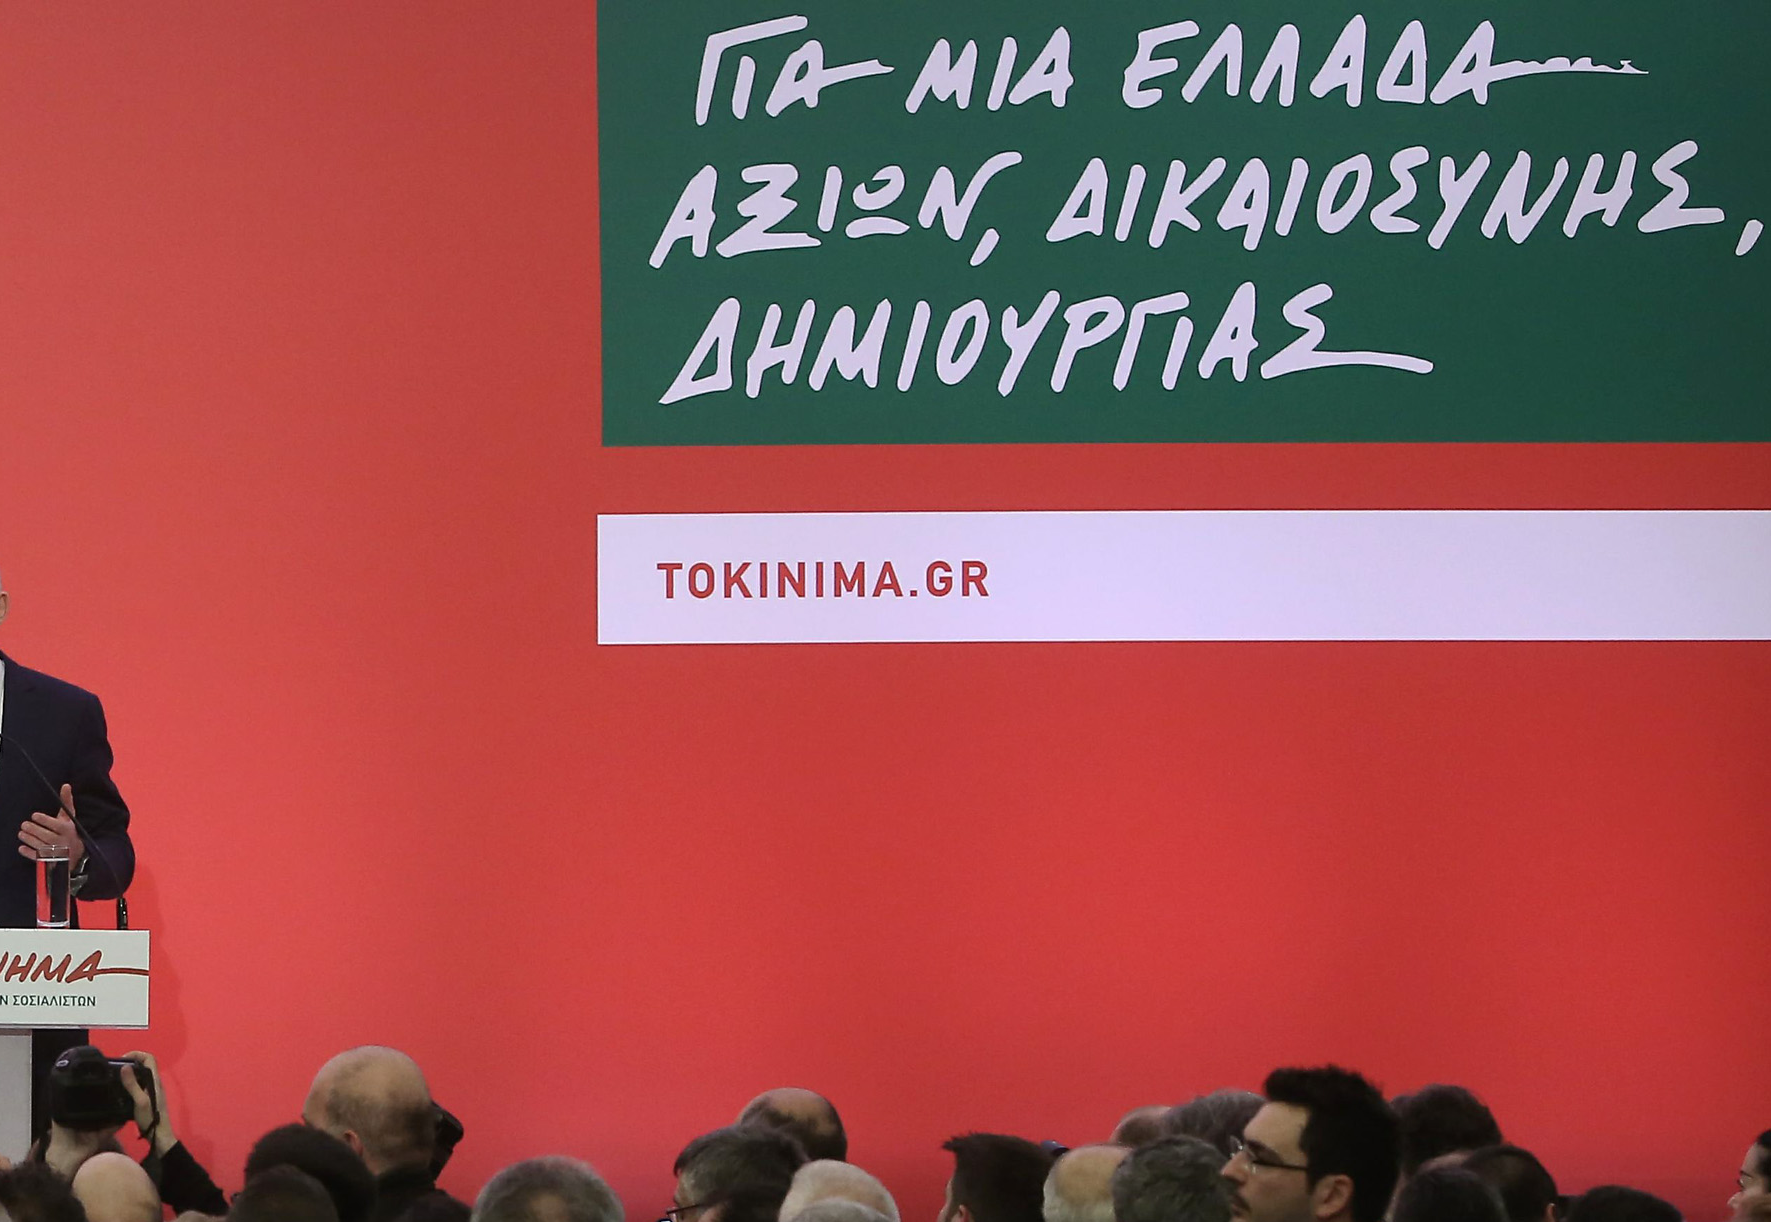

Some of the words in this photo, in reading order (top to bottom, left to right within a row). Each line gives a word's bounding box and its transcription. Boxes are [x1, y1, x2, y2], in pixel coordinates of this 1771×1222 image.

[696, 15, 894, 125] ΓΙΑ
[906, 27, 1073, 113] ΜΙΑ
[1122, 15, 1648, 108] ΕΛΛΑΔΑ
[649, 152, 1022, 268] ΑΞΙΩΝ,
[1046, 141, 1763, 255] ΔΙΚΑΙΟΣΥΝΗΣ,
[659, 282, 1433, 404] ΔΗΜΙΟΥΡΓΙΑΣ
[657, 561, 988, 599] TOKINIMA.GR
[13, 995, 95, 1006] ΣΟΣΙΑΛΙΣΤΩΝ
